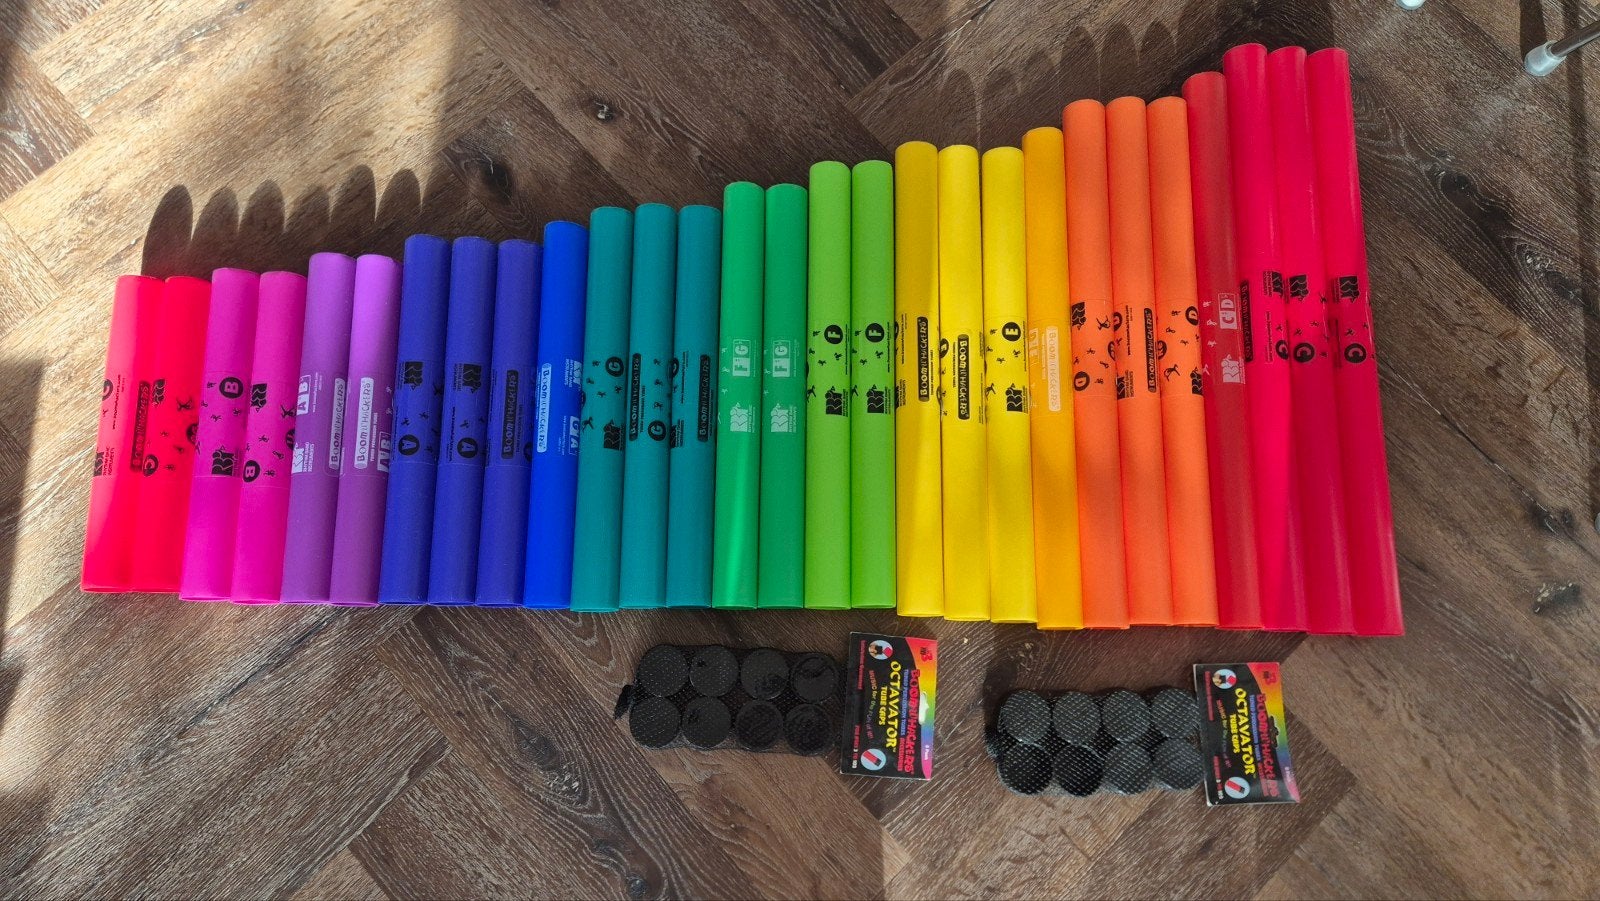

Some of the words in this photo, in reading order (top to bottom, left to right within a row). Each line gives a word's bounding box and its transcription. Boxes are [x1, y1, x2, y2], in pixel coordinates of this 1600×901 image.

[920, 321, 928, 396] BOOMWHACKERS
[960, 340, 968, 415] BOOMWHACKERS
[1146, 312, 1156, 386] BOOMWHACKERS
[357, 382, 371, 462] BOOMWHACKERS
[878, 706, 886, 726] CAPS
[879, 686, 888, 705] TUBE
[885, 661, 901, 748] OCTAVATOR
[904, 669, 920, 773] BOOMWHACKERS
[1229, 713, 1239, 734] TUBE
[1235, 688, 1255, 775] OCTAVATOR
